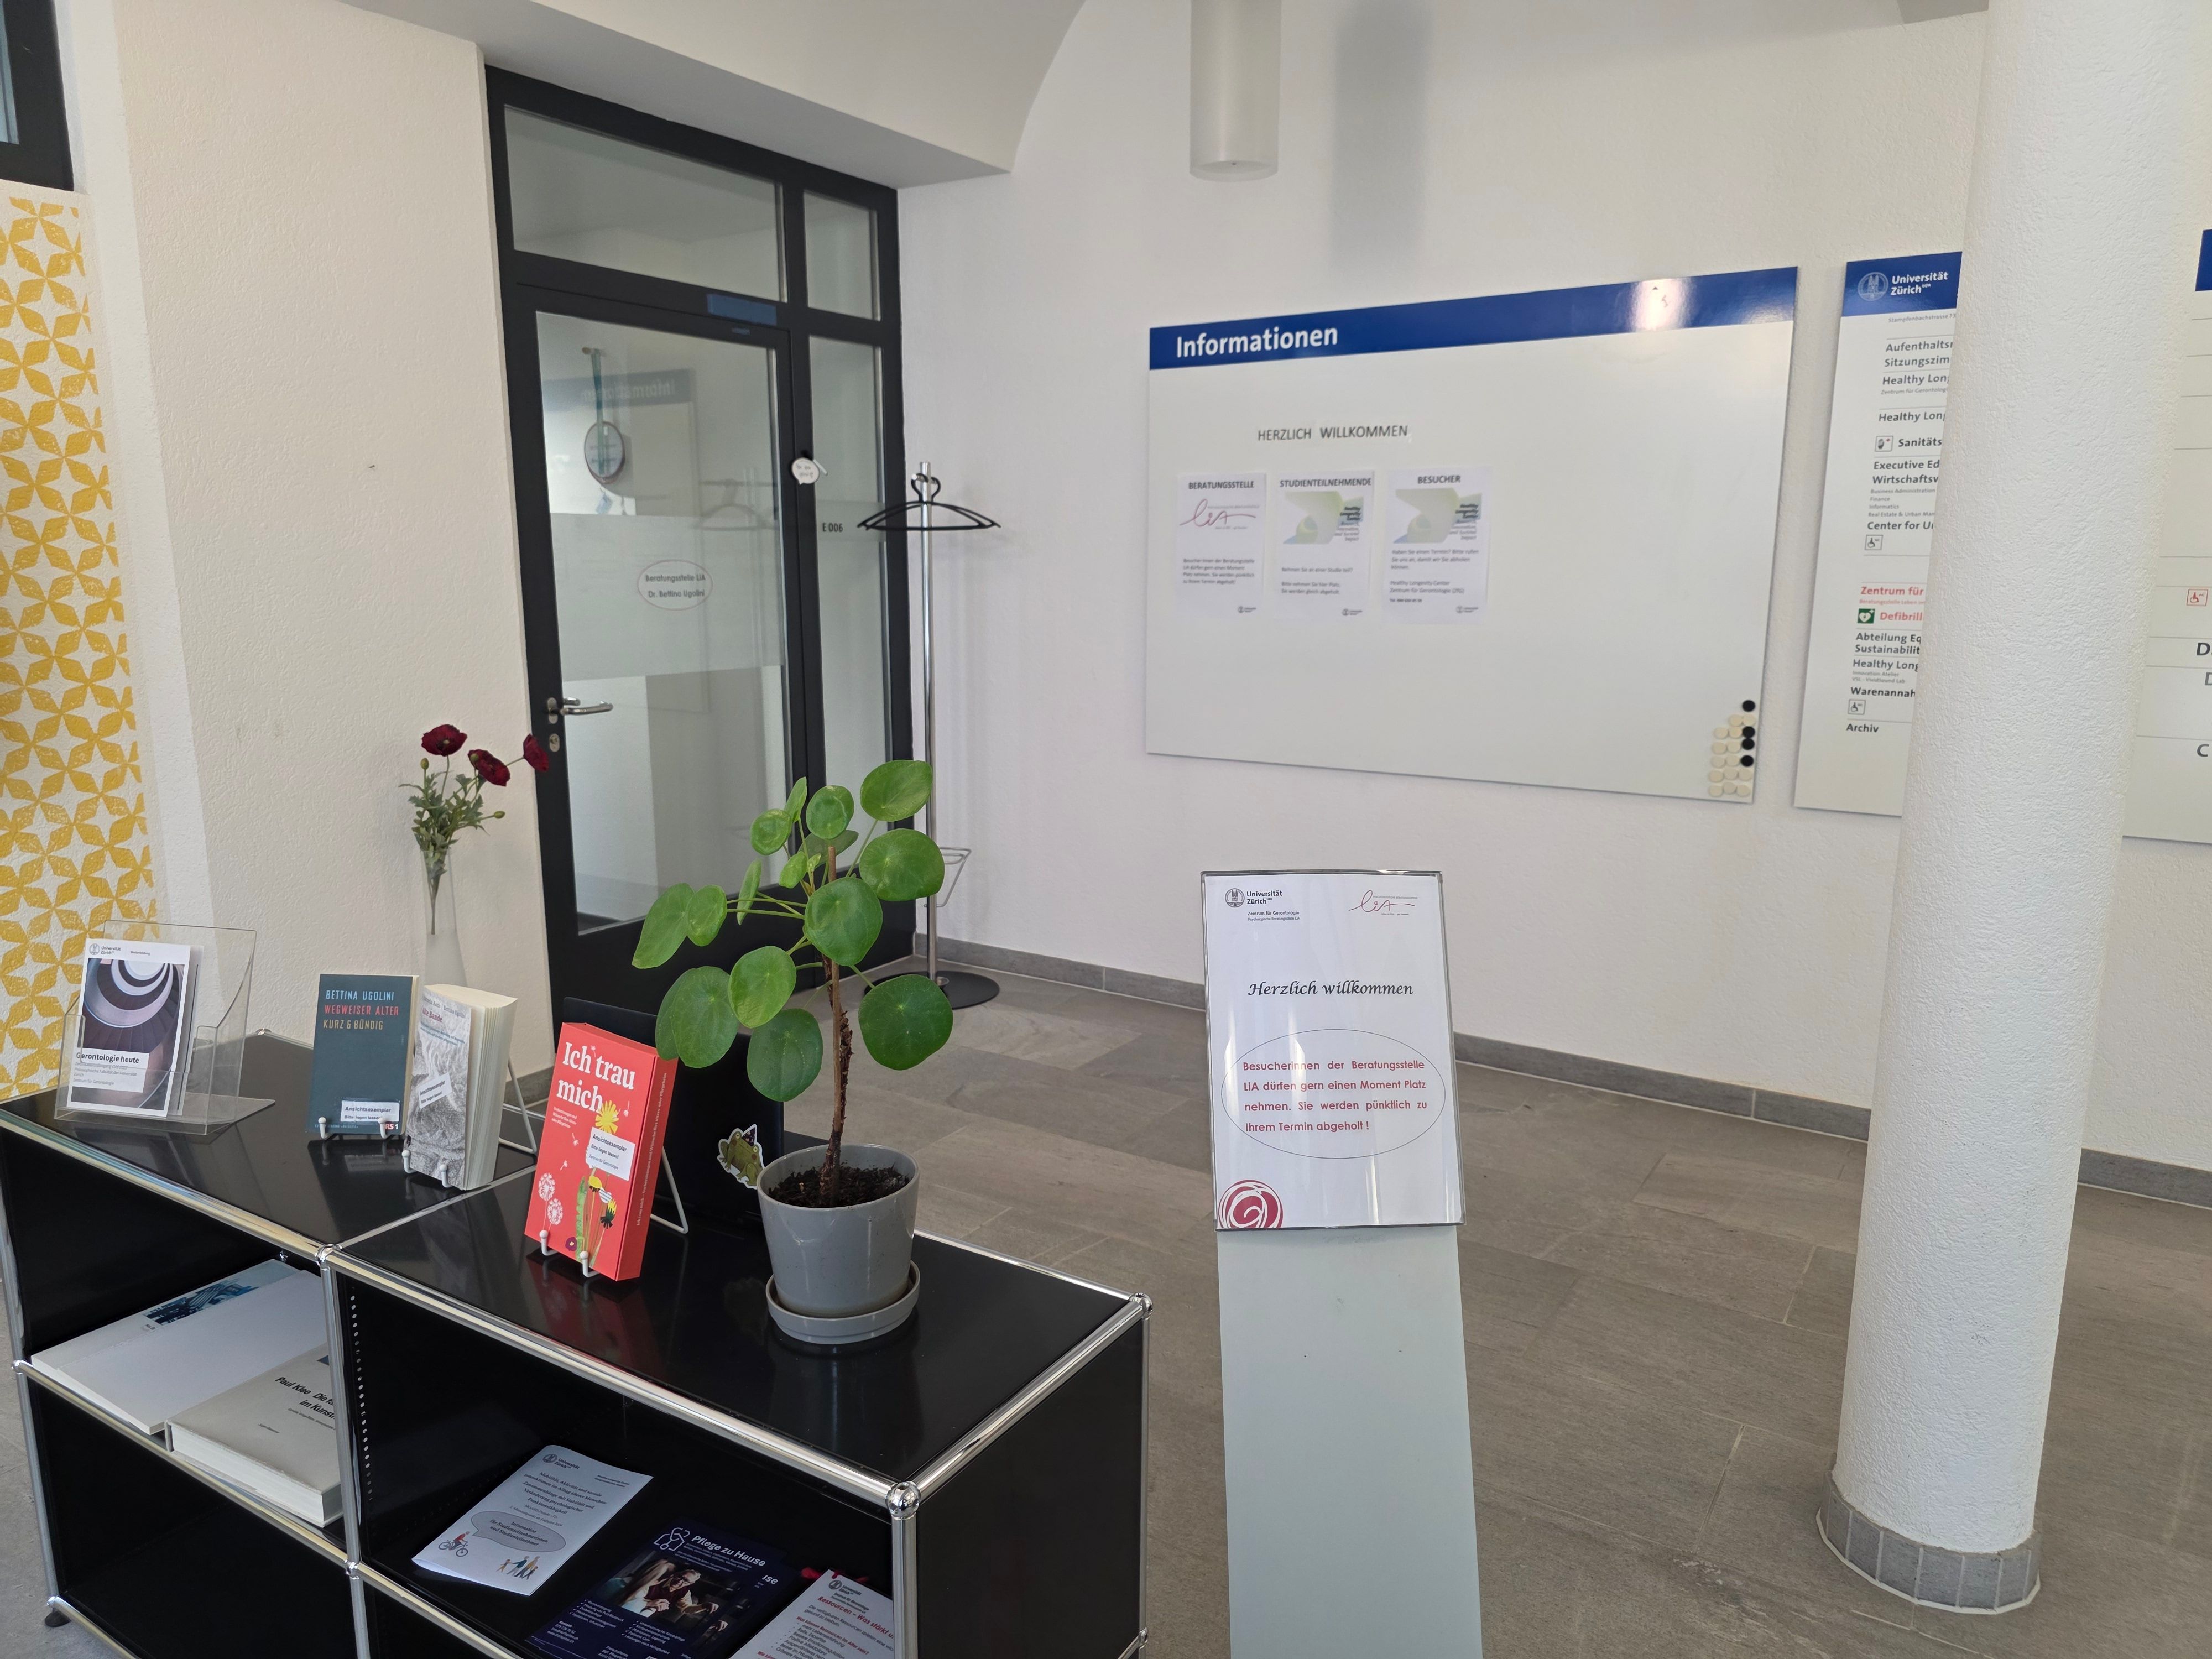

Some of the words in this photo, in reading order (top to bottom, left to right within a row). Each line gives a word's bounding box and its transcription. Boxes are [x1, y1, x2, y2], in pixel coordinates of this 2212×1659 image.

[1892, 272, 1948, 284] Universität
[1177, 326, 1338, 358] Informationen
[1882, 375, 1924, 385] Healthy
[1879, 412, 1920, 422] Healthy
[1258, 428, 1312, 441] HERZLICH
[1320, 425, 1408, 439] WILLKOMMEN
[1874, 461, 1924, 469] Executive
[1188, 481, 1254, 489] BERATUNGSSTELLE
[1280, 478, 1371, 487] STUDIENTEILNEHMENDE
[1417, 475, 1461, 484] BESUCHER
[823, 523, 826, 532] E
[829, 523, 843, 532] 006
[1867, 521, 1902, 530] Center
[1905, 521, 1920, 529] for
[645, 575, 695, 583] Beratungsstelle
[684, 589, 705, 598] Ugolini
[1861, 587, 1905, 595] Zentrum
[1908, 587, 1923, 596] für
[1856, 633, 1907, 644] Abteilung
[1853, 659, 1893, 671] Healthy
[1846, 723, 1879, 732] Archiv
[1248, 980, 1318, 995] Herzlich
[1322, 980, 1413, 995] willkommen
[326, 990, 358, 1000] BETTINA
[363, 991, 394, 1000] UGOLINI
[325, 1005, 371, 1015] WEGWEISER
[375, 1006, 399, 1015] ALTER
[324, 1019, 344, 1029] KURZ
[347, 1020, 351, 1029] &
[354, 1019, 383, 1030] BÜNDIG
[76, 1052, 119, 1062] Gerontologie
[562, 1042, 591, 1076] Ich
[595, 1055, 635, 1090] trau
[1243, 1061, 1319, 1071] Besucherinnen
[1327, 1060, 1344, 1070] der
[1352, 1060, 1425, 1071] Beratungsstelle
[420, 1081, 445, 1095] Ansichtsexemplar
[1244, 1082, 1259, 1091] LiA
[1263, 1081, 1296, 1091] dürfen
[1300, 1082, 1324, 1092] gern
[1328, 1081, 1357, 1089] einen
[1360, 1080, 1401, 1089] Moment
[1405, 1080, 1426, 1089] Platz
[556, 1078, 603, 1113] mich
[1245, 1102, 1291, 1111] nehmen.
[1298, 1102, 1313, 1110] Sie
[1320, 1100, 1359, 1110] werden
[1366, 1100, 1411, 1112] pünktlich
[1245, 1123, 1275, 1131] Ihrem
[1279, 1121, 1313, 1131] Termin
[1317, 1121, 1363, 1133] abgeholt
[592, 1134, 627, 1152] Ansichtsexemplar
[275, 1377, 296, 1387] Paul
[292, 1384, 311, 1394] Klee
[557, 1458, 580, 1469] Universität
[523, 1473, 552, 1485] Interaktionen
[560, 1481, 580, 1489] Aktivität
[523, 1481, 558, 1496] Zusammenhänge
[566, 1497, 585, 1506] Stabilität
[524, 1488, 551, 1502] Veränderung
[549, 1499, 583, 1512] psychologischer
[528, 1498, 567, 1515] Funktionsfähigkeit
[498, 1522, 548, 1542] Studienteilnehmerinnen
[511, 1521, 536, 1533] Information
[499, 1530, 539, 1546] Studienteilnehmer
[692, 1535, 721, 1550] Pflege
[734, 1551, 765, 1566] Hause
[817, 1596, 852, 1614] Ressourcen
[857, 1614, 871, 1624] Was
[870, 1622, 889, 1634] stärkt
